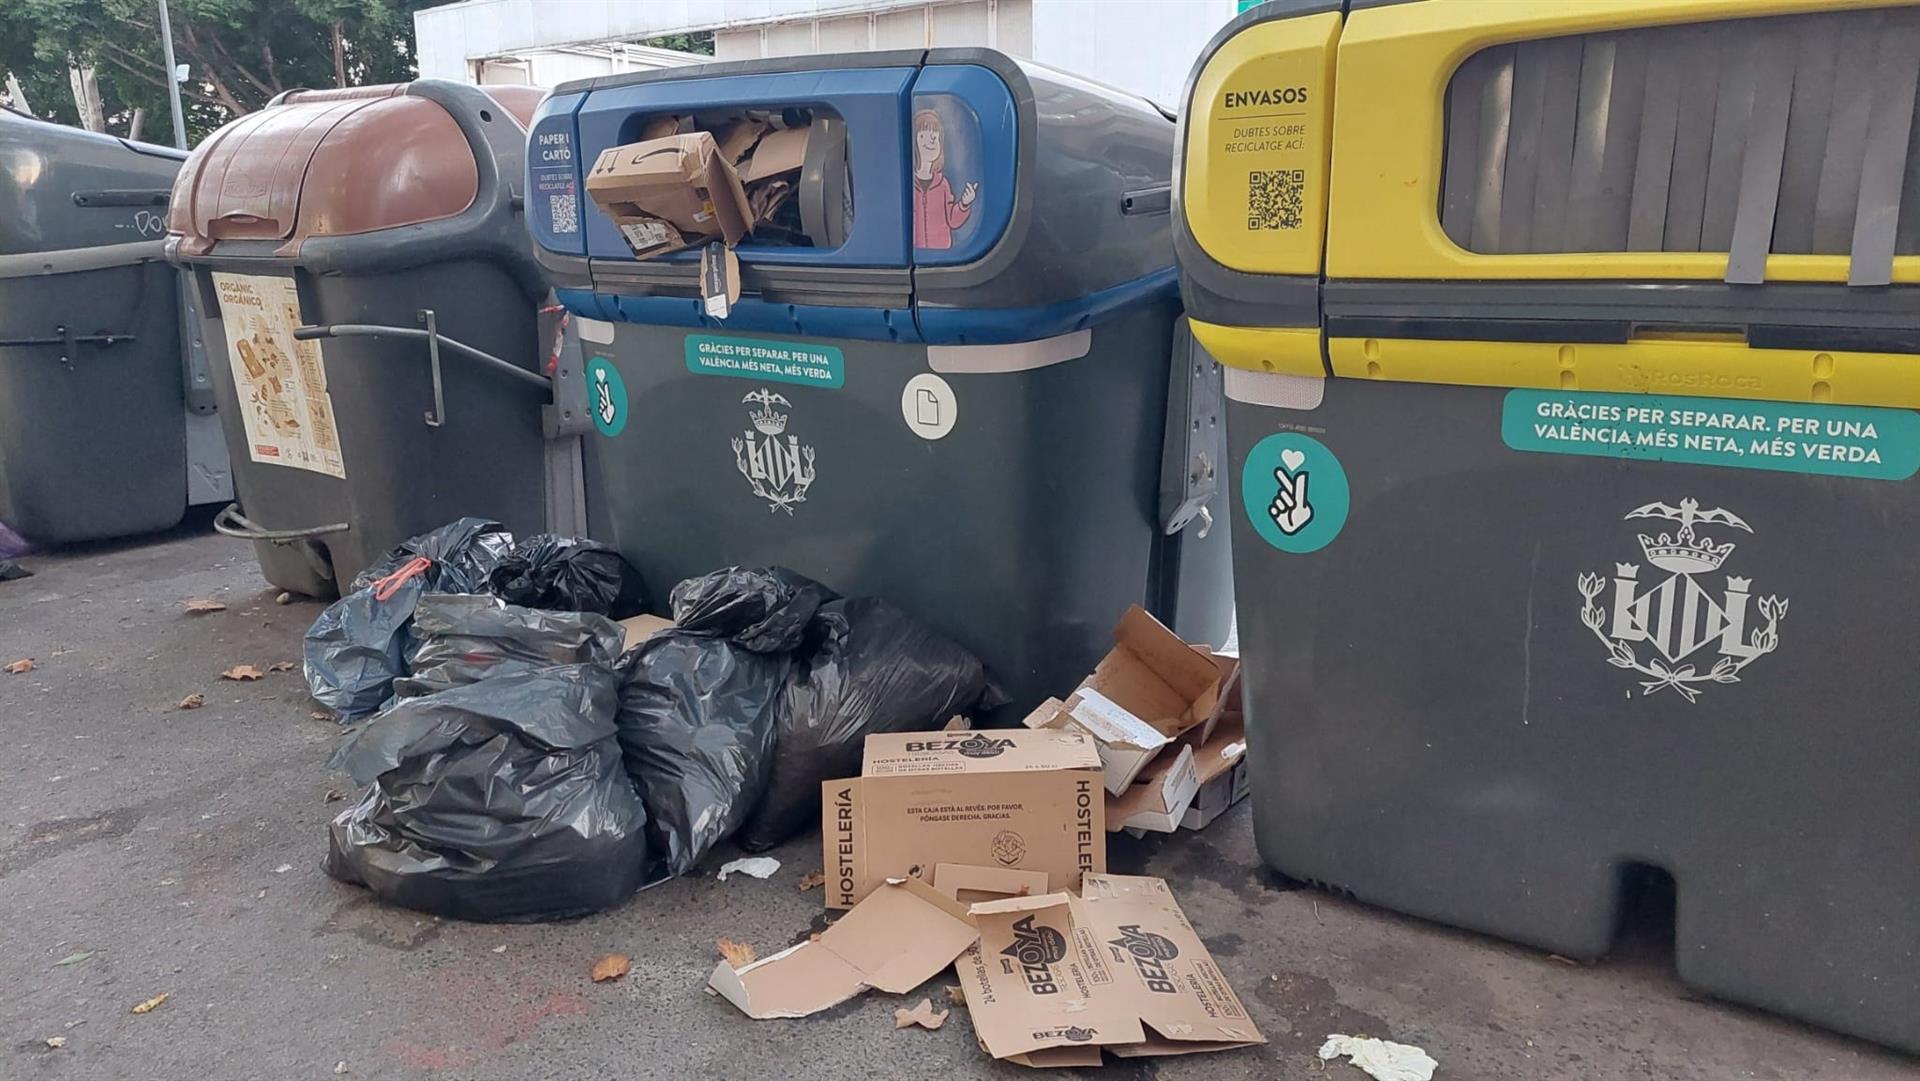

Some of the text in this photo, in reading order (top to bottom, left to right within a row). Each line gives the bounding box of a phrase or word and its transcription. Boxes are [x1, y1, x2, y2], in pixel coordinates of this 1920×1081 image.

[1225, 87, 1308, 108] ENVASOS
[539, 133, 564, 145] PAPER
[1233, 125, 1305, 139] DUBTES SOBRE
[542, 146, 571, 161] CARTÓ
[1225, 140, 1283, 153] RECICLATGE
[699, 342, 829, 366] GRÀCIES PER SEPARAR. PER UNA
[699, 355, 832, 380] VALÈNCIA MÉS NETA, MÉS VERDA
[1536, 400, 1878, 439] GRÀCIES PER SEPARAR. PER UNA
[1534, 423, 1881, 464] VALÈNCIA MÉS NETA, MÉS VERDA
[906, 738, 1017, 752] BEZOYA
[923, 806, 939, 814] CAJA
[1077, 780, 1093, 888] HOSTELER
[834, 788, 854, 906] HOSTELERÍA
[1012, 914, 1058, 995] BEZOYA
[1117, 924, 1178, 994] BEZOYA
[975, 965, 992, 995] botellas
[1032, 1027, 1099, 1040] BEZOYA
